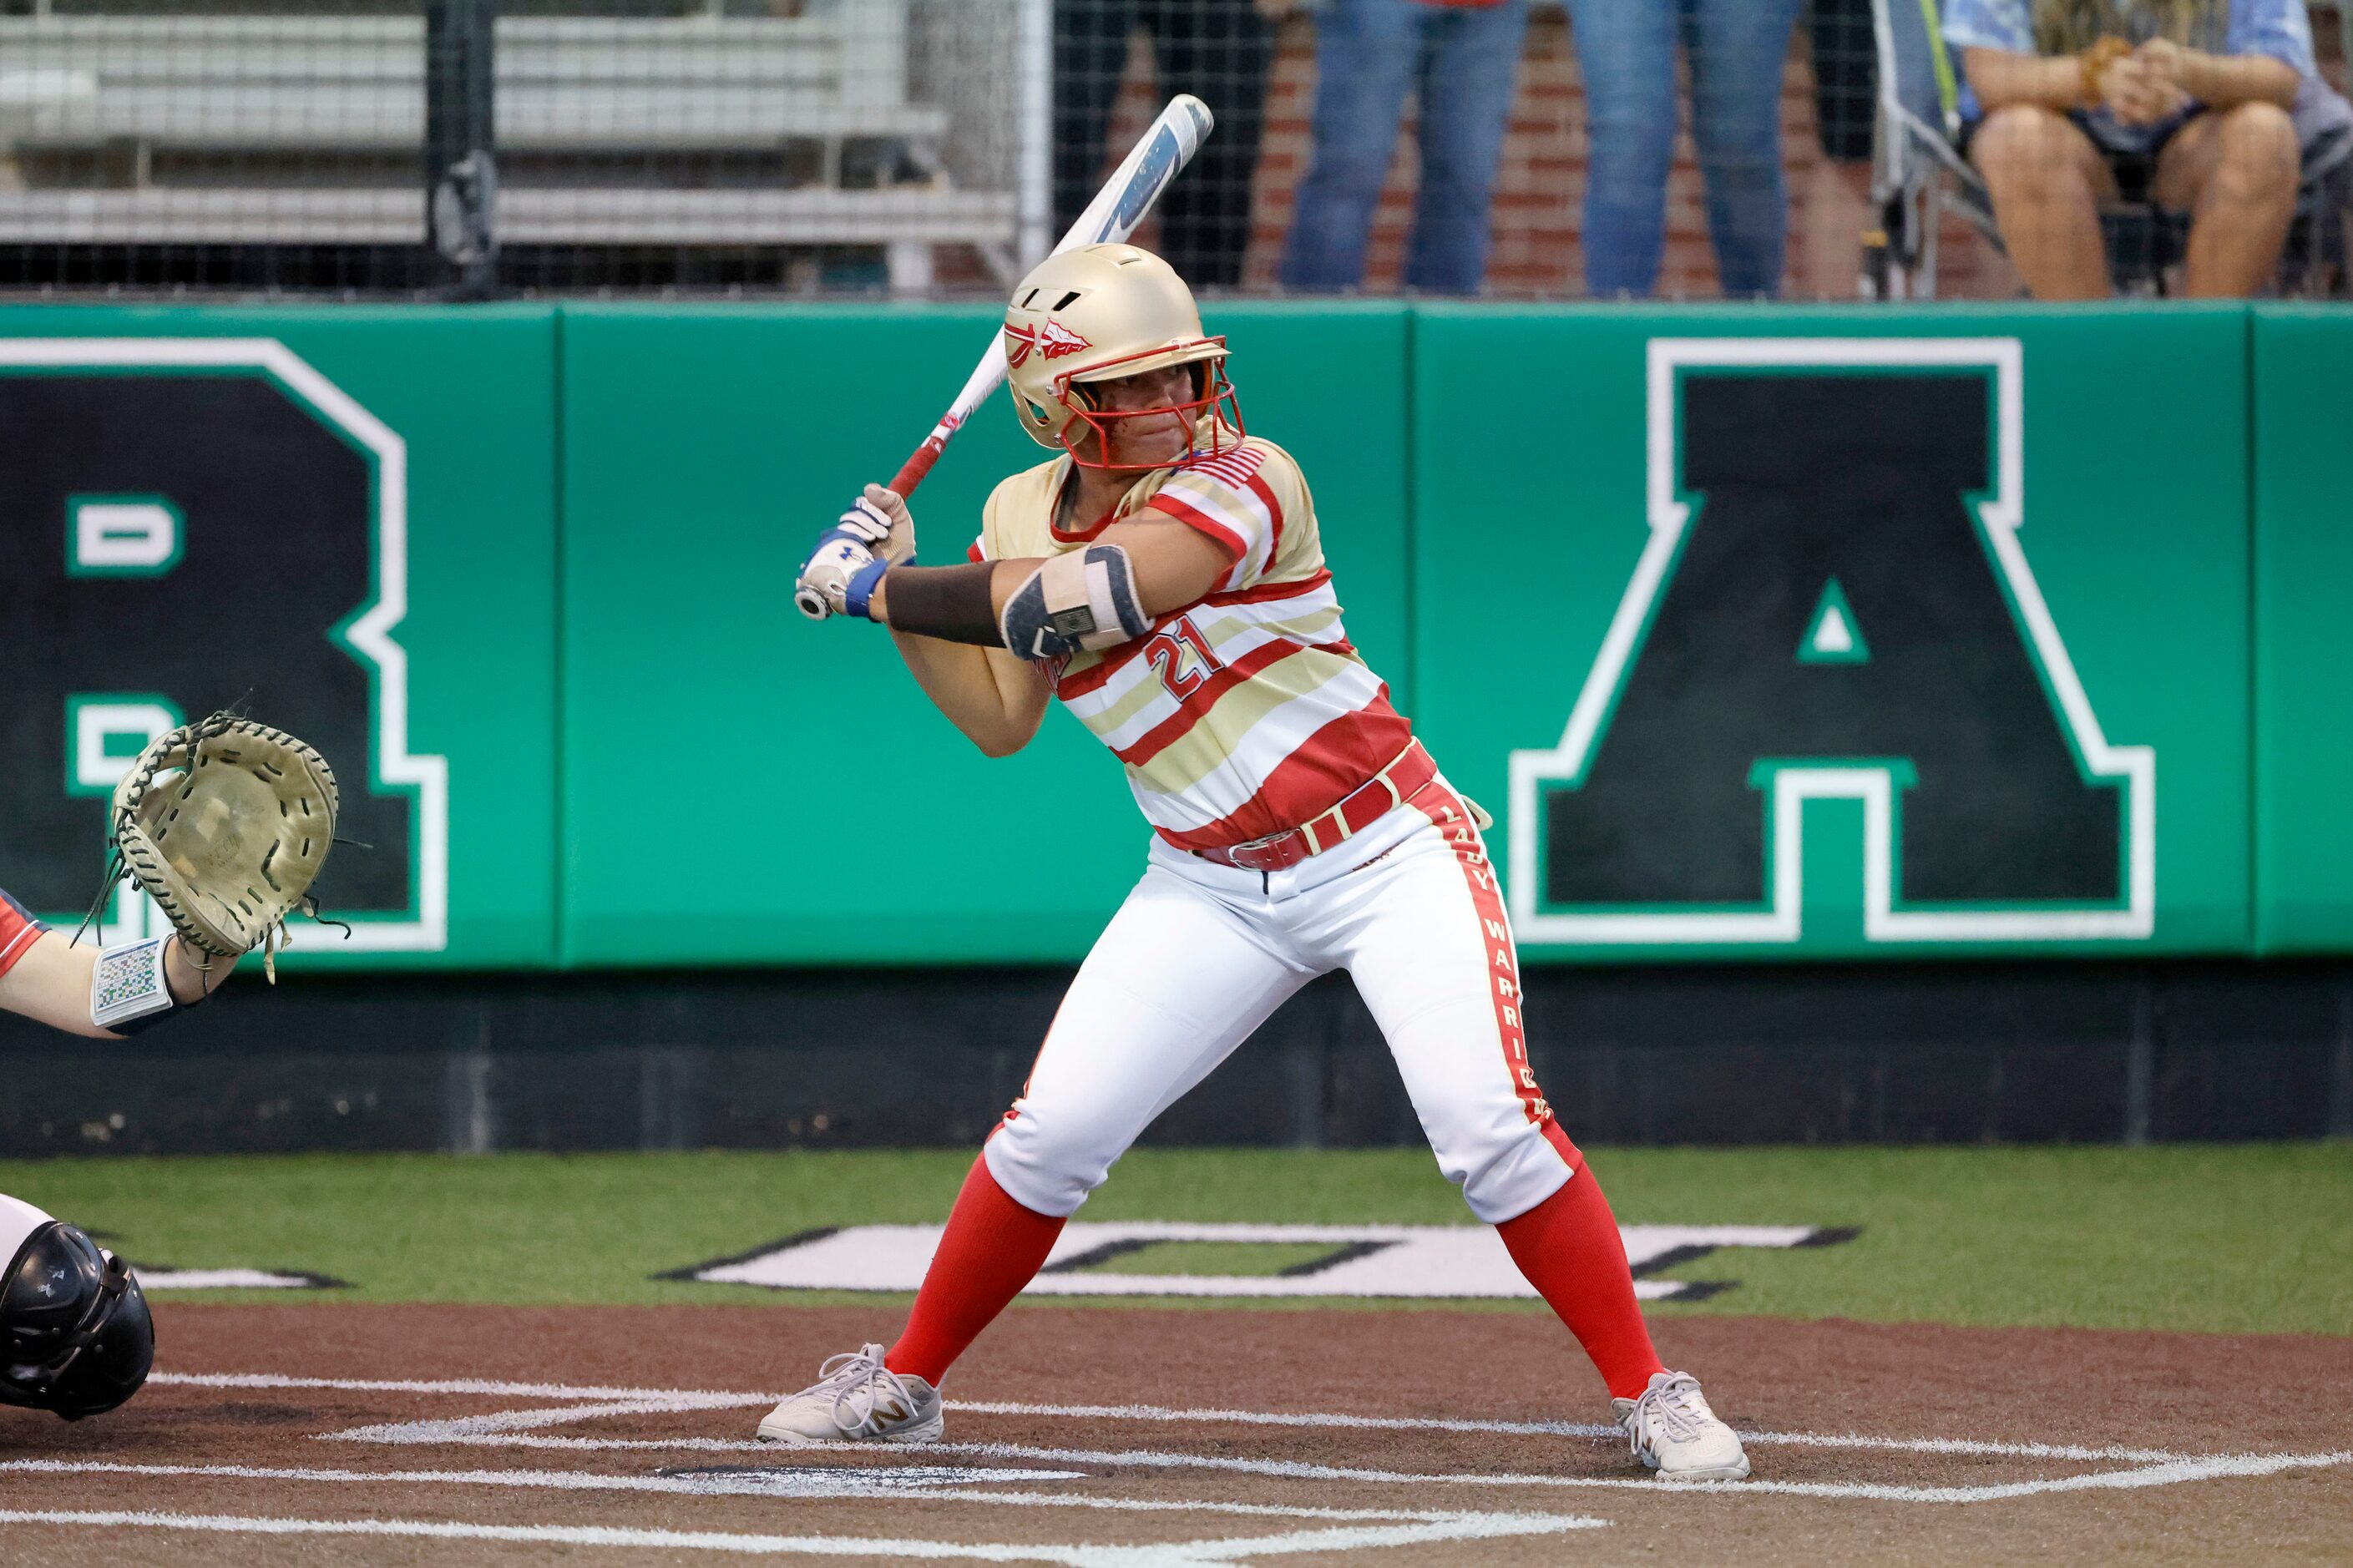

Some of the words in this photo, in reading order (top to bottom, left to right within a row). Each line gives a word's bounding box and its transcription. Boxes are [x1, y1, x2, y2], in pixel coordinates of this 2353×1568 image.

[1143, 614, 1226, 703] 21
[1508, 337, 2155, 943] A
[1439, 805, 1488, 891] LADY
